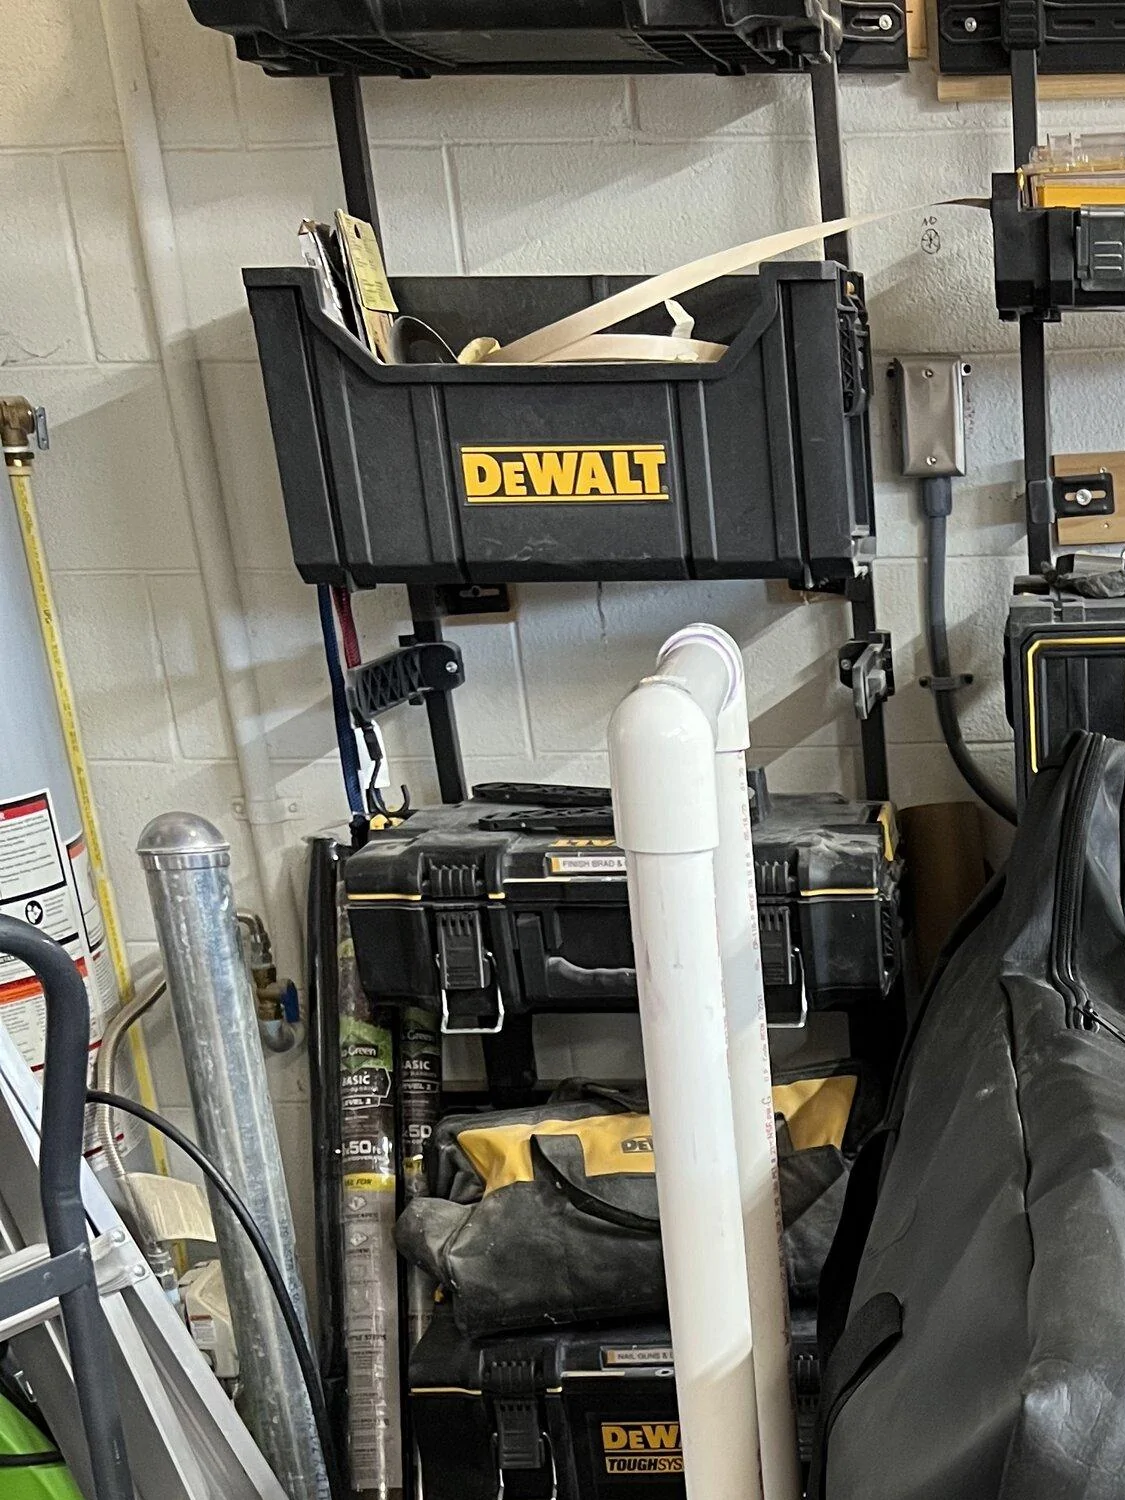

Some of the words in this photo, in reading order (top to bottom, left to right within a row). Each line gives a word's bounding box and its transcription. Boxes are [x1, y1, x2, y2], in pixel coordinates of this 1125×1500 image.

[461, 451, 668, 496] DEWALT
[403, 1060, 431, 1070] ASIC
[602, 1424, 681, 1449] DEW
[607, 1458, 683, 1472] TOUGHSYS
